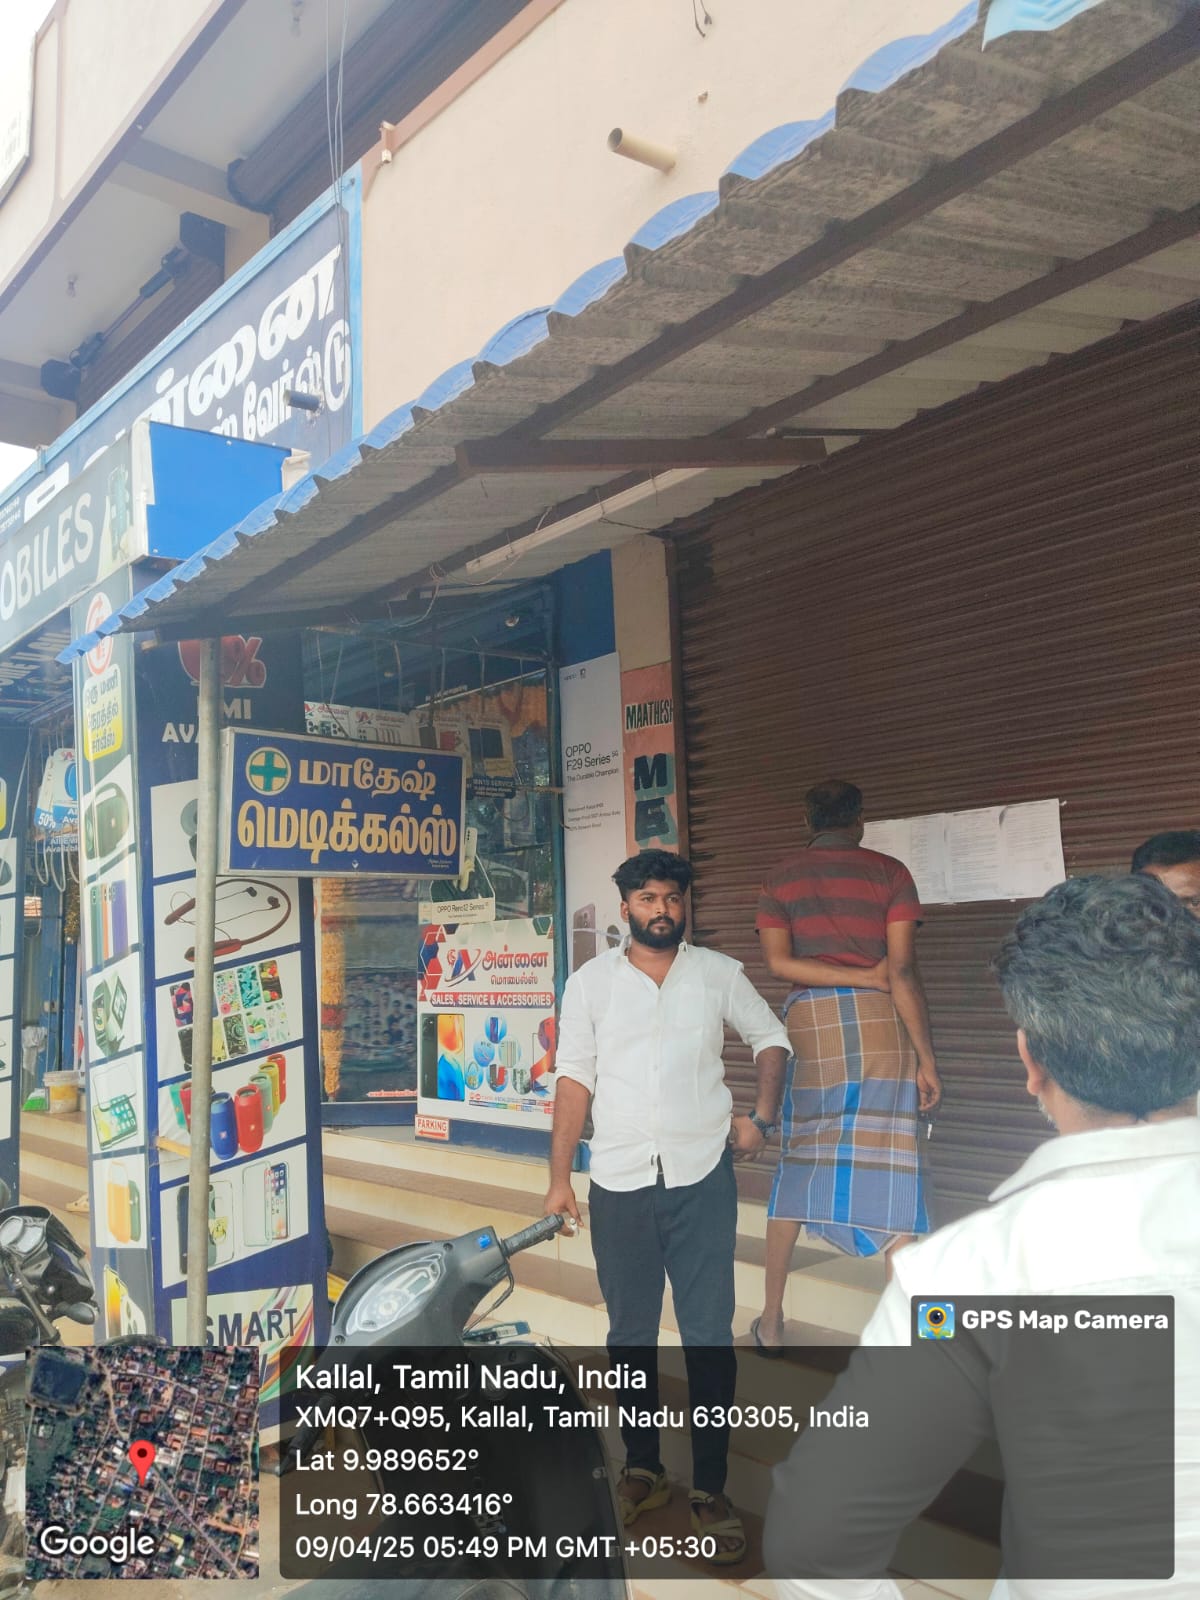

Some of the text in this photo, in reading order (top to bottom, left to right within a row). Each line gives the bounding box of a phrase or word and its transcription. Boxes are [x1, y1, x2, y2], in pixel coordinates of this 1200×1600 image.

[565, 742, 592, 757] OPPO
[566, 758, 583, 772] F29
[584, 753, 611, 768] Series
[299, 757, 437, 801] மாதேஷ்
[238, 798, 457, 864] மெடிக்கல்ஸ்
[482, 944, 549, 971] அன்னை
[431, 991, 552, 1006] SALES, SERVICE & ACCESSORIES
[417, 1118, 447, 1132] PARKING
